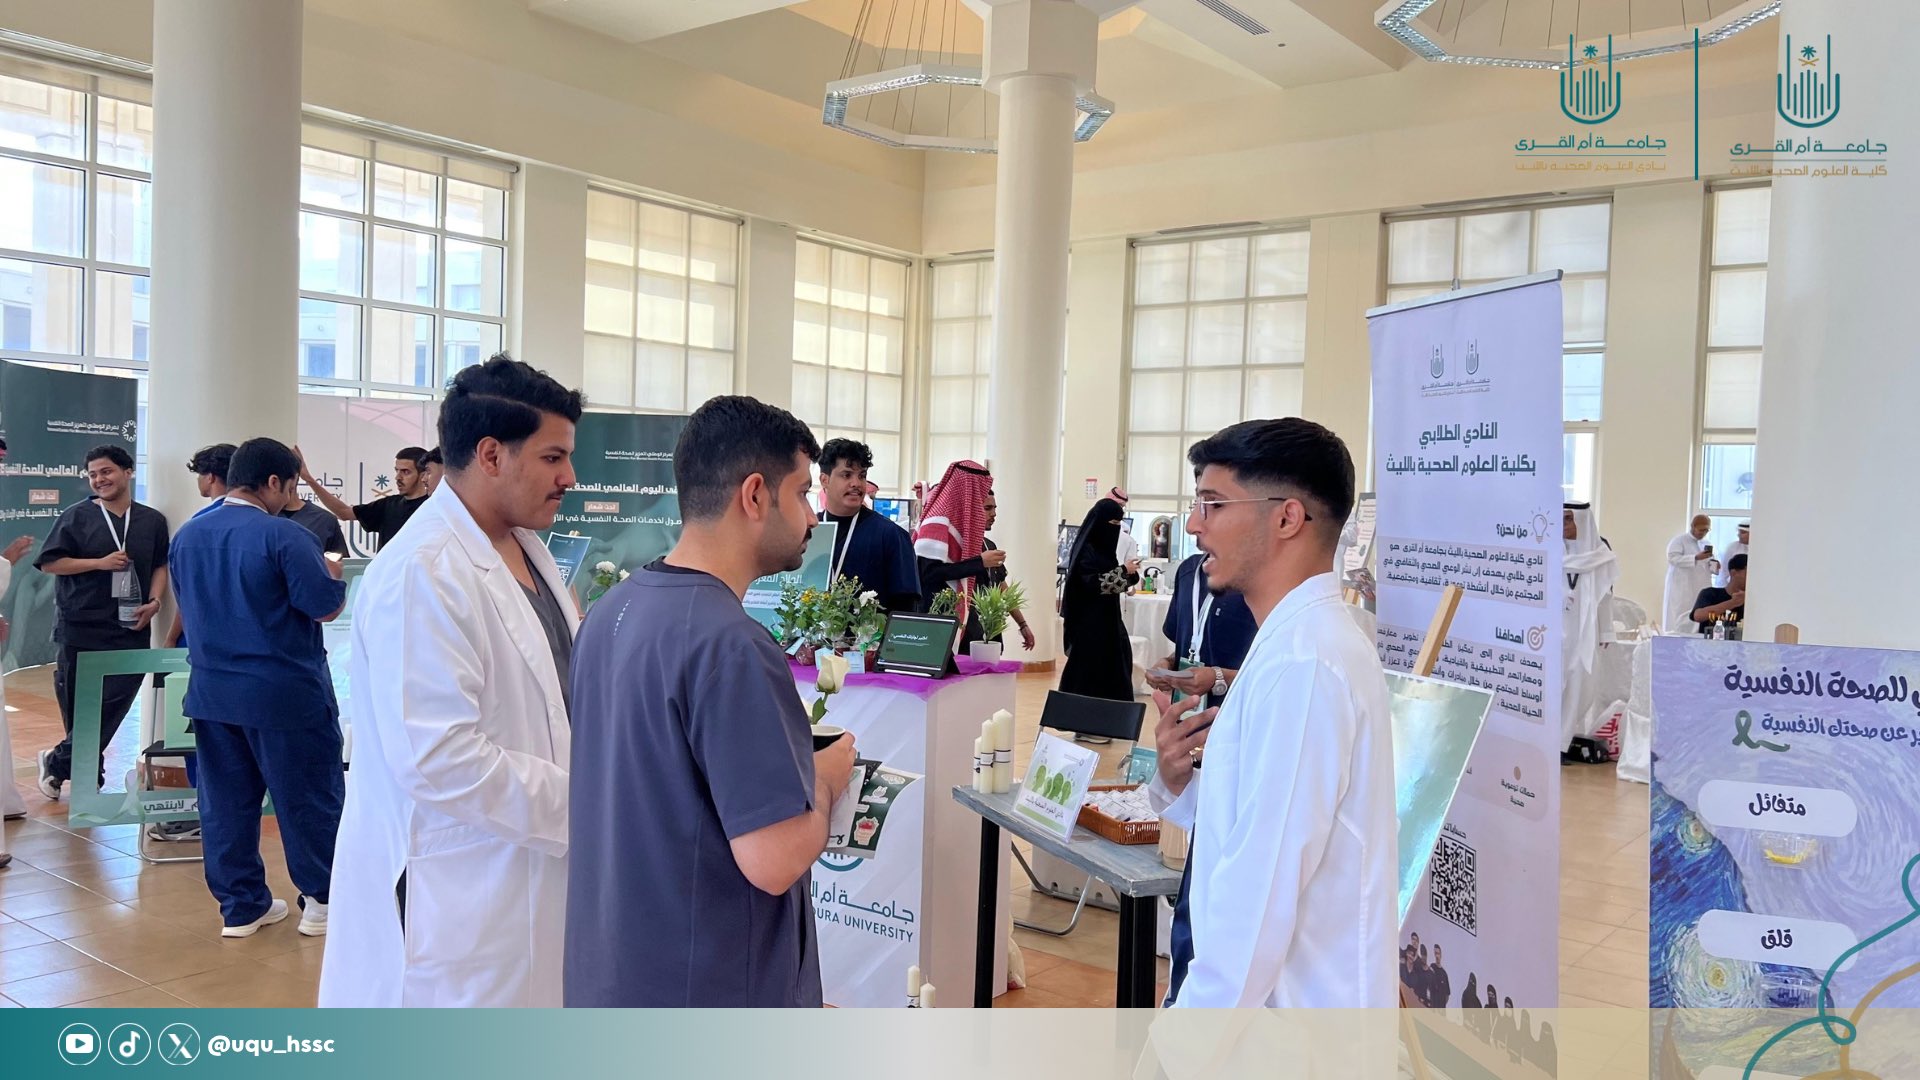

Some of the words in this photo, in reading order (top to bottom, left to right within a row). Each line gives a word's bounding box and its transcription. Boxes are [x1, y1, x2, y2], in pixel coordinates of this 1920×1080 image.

[1419, 423, 1461, 449] الطلابي
[1463, 422, 1498, 448] النادي
[22, 463, 44, 475] للصحة
[45, 464, 78, 478] العالمي
[1386, 453, 1416, 476] بالليث
[1418, 456, 1459, 476] الصحية
[1461, 455, 1498, 476] العلوم
[1501, 454, 1536, 476] بكلية
[575, 482, 601, 492] للصحة
[603, 483, 639, 494] العالمي
[640, 484, 664, 495] اليوم
[564, 514, 579, 523] في
[580, 514, 612, 524] النفسية
[612, 515, 636, 523] الصحة
[638, 515, 664, 525] لخدمات
[1496, 522, 1514, 537] نحن؟
[1515, 525, 1528, 538] من
[1389, 544, 1400, 552] هو
[1425, 545, 1447, 556] بجامعة
[1464, 549, 1487, 560] الصحية
[1383, 557, 1393, 567] في
[1489, 551, 1509, 562] العلوم
[1510, 553, 1525, 565] كلية
[1526, 555, 1543, 567] نادي
[1421, 560, 1441, 572] الصحي
[1442, 563, 1461, 574] الوعي
[1482, 569, 1506, 580] يهدف
[1507, 570, 1525, 582] طلابي
[1527, 572, 1543, 585] نادي
[1505, 588, 1514, 599] من
[1515, 590, 1543, 602] المجتمع
[1495, 626, 1524, 646] أهدافنا
[1499, 653, 1515, 664] النادي
[1520, 657, 1542, 671] يهدف
[1724, 664, 1824, 698] النفسية
[1827, 671, 1908, 704] للصحة
[1521, 689, 1542, 703] أوساط
[1522, 705, 1542, 718] الحياة
[1761, 713, 1825, 736] النفسية
[1828, 718, 1878, 740] صحتك
[1880, 726, 1908, 742] عن
[143, 799, 199, 812] م_لاينتهي
[1748, 792, 1806, 816] متفائل
[820, 882, 836, 904] أم
[838, 888, 915, 925] جامعة
[844, 914, 914, 943] UNIVERSITY
[1760, 928, 1793, 950] قلق
